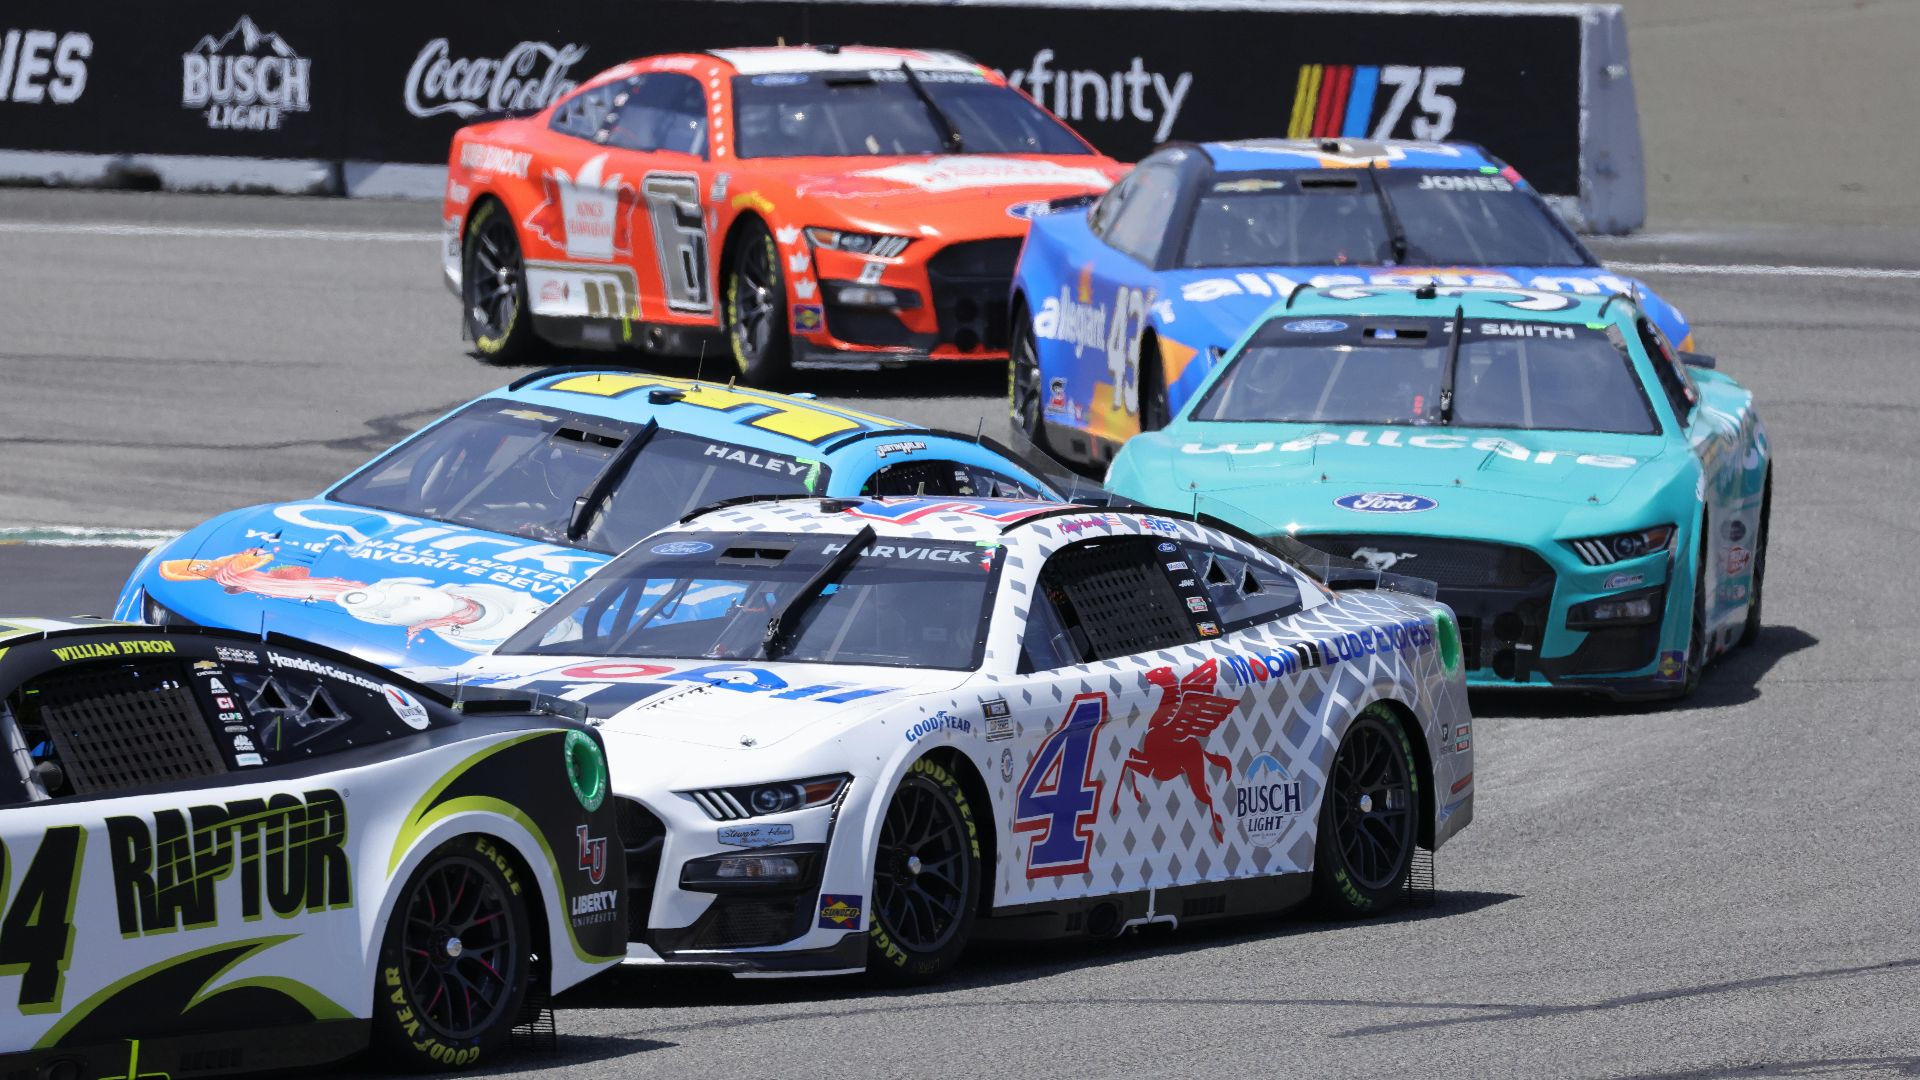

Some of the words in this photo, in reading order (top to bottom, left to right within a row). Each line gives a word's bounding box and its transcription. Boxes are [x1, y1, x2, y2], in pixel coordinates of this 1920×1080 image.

[182, 54, 310, 108] BUSCH
[208, 106, 281, 129] LIGHT
[1374, 66, 1464, 142] 75
[1418, 175, 1514, 191] JONES
[1481, 322, 1575, 340] SMITH
[704, 444, 808, 477] HALEY
[466, 557, 578, 588] WATER
[51, 643, 120, 661] WILLIAM
[119, 640, 176, 655] BYRON
[1226, 645, 1297, 686] Mobil
[1318, 629, 1377, 665] Lube
[1376, 617, 1431, 656] Express
[1012, 691, 1108, 880] 4
[1237, 782, 1301, 817] BUSCH
[1248, 816, 1284, 832] LIGHT
[104, 788, 353, 939] RAPTOR
[475, 836, 522, 896] EAGLE
[572, 889, 617, 916] LIBERTY
[0, 825, 88, 1016] 4
